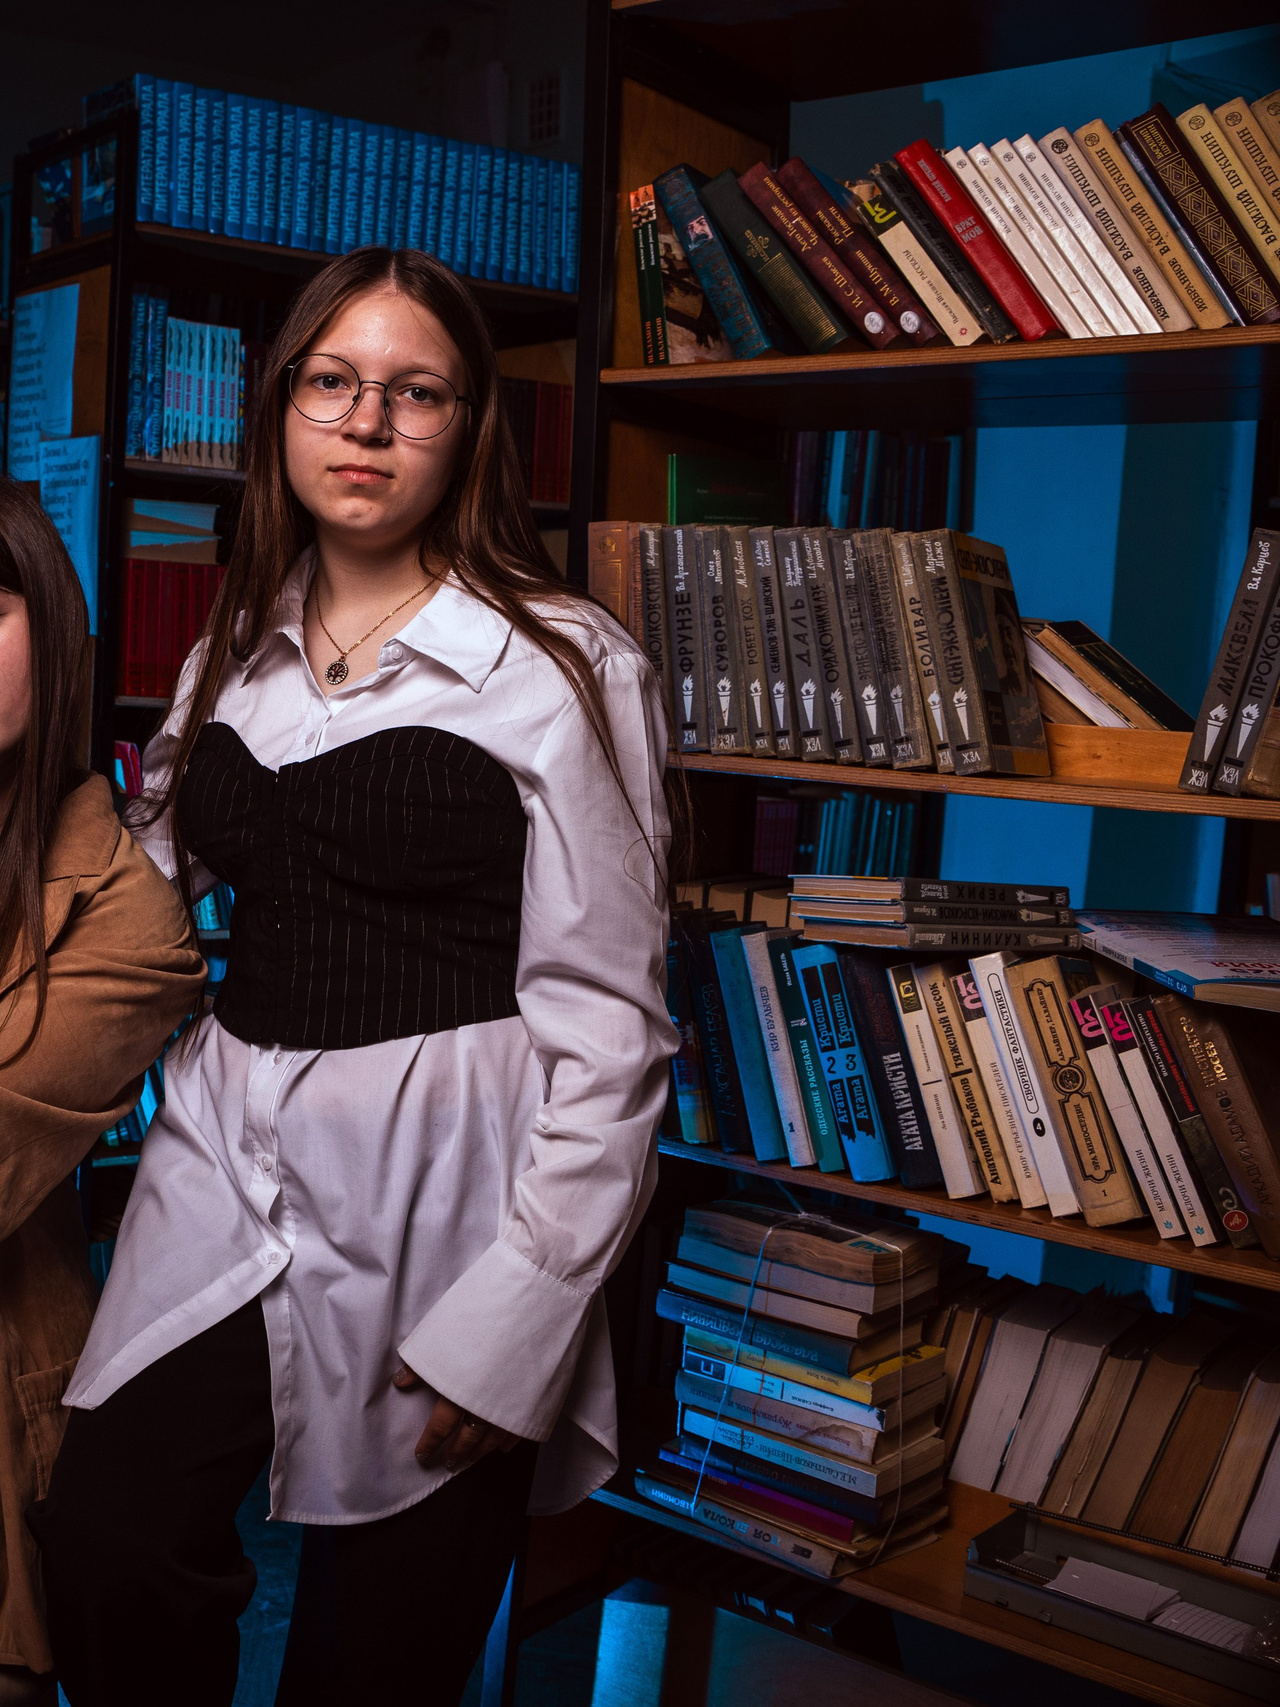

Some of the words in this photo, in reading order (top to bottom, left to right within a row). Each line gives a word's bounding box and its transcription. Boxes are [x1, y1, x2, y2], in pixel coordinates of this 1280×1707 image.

[1138, 127, 1164, 161] ВАСИЛИЙ
[1146, 122, 1171, 156] ШУКШИН
[1199, 129, 1243, 190] ШУКШИН
[1236, 125, 1279, 187] ШУКШИН
[762, 173, 793, 209] ресторана
[1061, 153, 1102, 208] ШУКШИН
[1095, 147, 1138, 206] ШУКШИН
[769, 202, 797, 236] Господне
[812, 208, 844, 245] Рассказы
[827, 204, 854, 237] Повести
[953, 212, 976, 234] БРАТ
[1093, 206, 1135, 262] ВАСИЛИЙ
[1128, 200, 1172, 256] ВАСИЛИЙ
[1235, 188, 1278, 246] ВАСИЛИЙ
[791, 231, 811, 253] Лето
[901, 247, 928, 280] РАССКАЗЫ
[818, 254, 848, 287] Шмелев
[852, 247, 884, 284] Шукшин
[877, 280, 892, 296] М.
[1166, 256, 1209, 313] ИЗБРАННОЕ
[886, 292, 900, 306] В.
[1130, 264, 1171, 321] ИЗБРАННОЕ
[647, 320, 655, 364] ШАЛАМОВ
[656, 316, 666, 361] ШАЛАМОВ
[1250, 539, 1271, 575] Карцев
[741, 597, 753, 621] КОХ
[930, 575, 965, 686] СЕНТ-ЭКЗЮПЕРИ
[675, 592, 694, 672] ФРУНЗЕ
[712, 595, 728, 672] СУВОРОВ
[744, 625, 758, 665] РОБЕРТ
[790, 598, 811, 667] ДАЛЬ
[810, 582, 839, 683] ОРДЖОНИКИДЗЕ
[909, 597, 935, 678] БОЛИВАР
[1217, 596, 1259, 698] МАКСВЕЛЛ
[1248, 598, 1280, 699] ПРОКОФ
[940, 907, 1018, 921] РИМСКИЙ-КОРСАКОВ
[956, 885, 1006, 901] РЕРИХ
[951, 931, 1021, 947] КАЛИНИН
[757, 984, 776, 1029] БУЛЫЧЕВ
[809, 996, 835, 1048] Кристи
[828, 991, 854, 1044] Кристи
[994, 988, 1020, 1055] ФАНТАСТИКИ
[767, 1030, 781, 1052] КИР
[798, 1038, 818, 1088] РАССКАЗЫ
[846, 1054, 856, 1071] 3
[1135, 1011, 1158, 1052] ОБИТАЕМЫЙ
[1152, 1051, 1168, 1078] ОСТРОВ
[827, 1057, 836, 1074] 2
[882, 1051, 913, 1111] КРИСТИ
[987, 1060, 1010, 1108] ПИСАТЕЛЕЙ
[1014, 1056, 1034, 1102] СБОРНИК
[809, 1088, 829, 1136] ОДЕССКИЕ
[830, 1082, 849, 1125] Агата
[848, 1077, 870, 1121] Агата
[959, 1076, 983, 1128] Рыбаков
[1213, 1087, 1248, 1146] АДАМОВ
[897, 1109, 924, 1154] АГАТА
[1003, 1108, 1025, 1154] СЕРЬЕЗНЫХ
[1035, 1124, 1043, 1134] 4
[1072, 1102, 1097, 1155] МИЛОСЕРДИЯ
[973, 1127, 1002, 1187] Анатолий
[1017, 1154, 1032, 1179] ЮМОР
[1089, 1154, 1101, 1171] ЭРА
[1134, 1148, 1152, 1179] ЖИЗНИ
[1164, 1152, 1184, 1185] ЖИЗНИ
[1236, 1144, 1274, 1209] АРКАДИЙ
[1145, 1177, 1166, 1213] МЕЛОЧИ
[1176, 1182, 1198, 1218] МЕЛОЧИ
